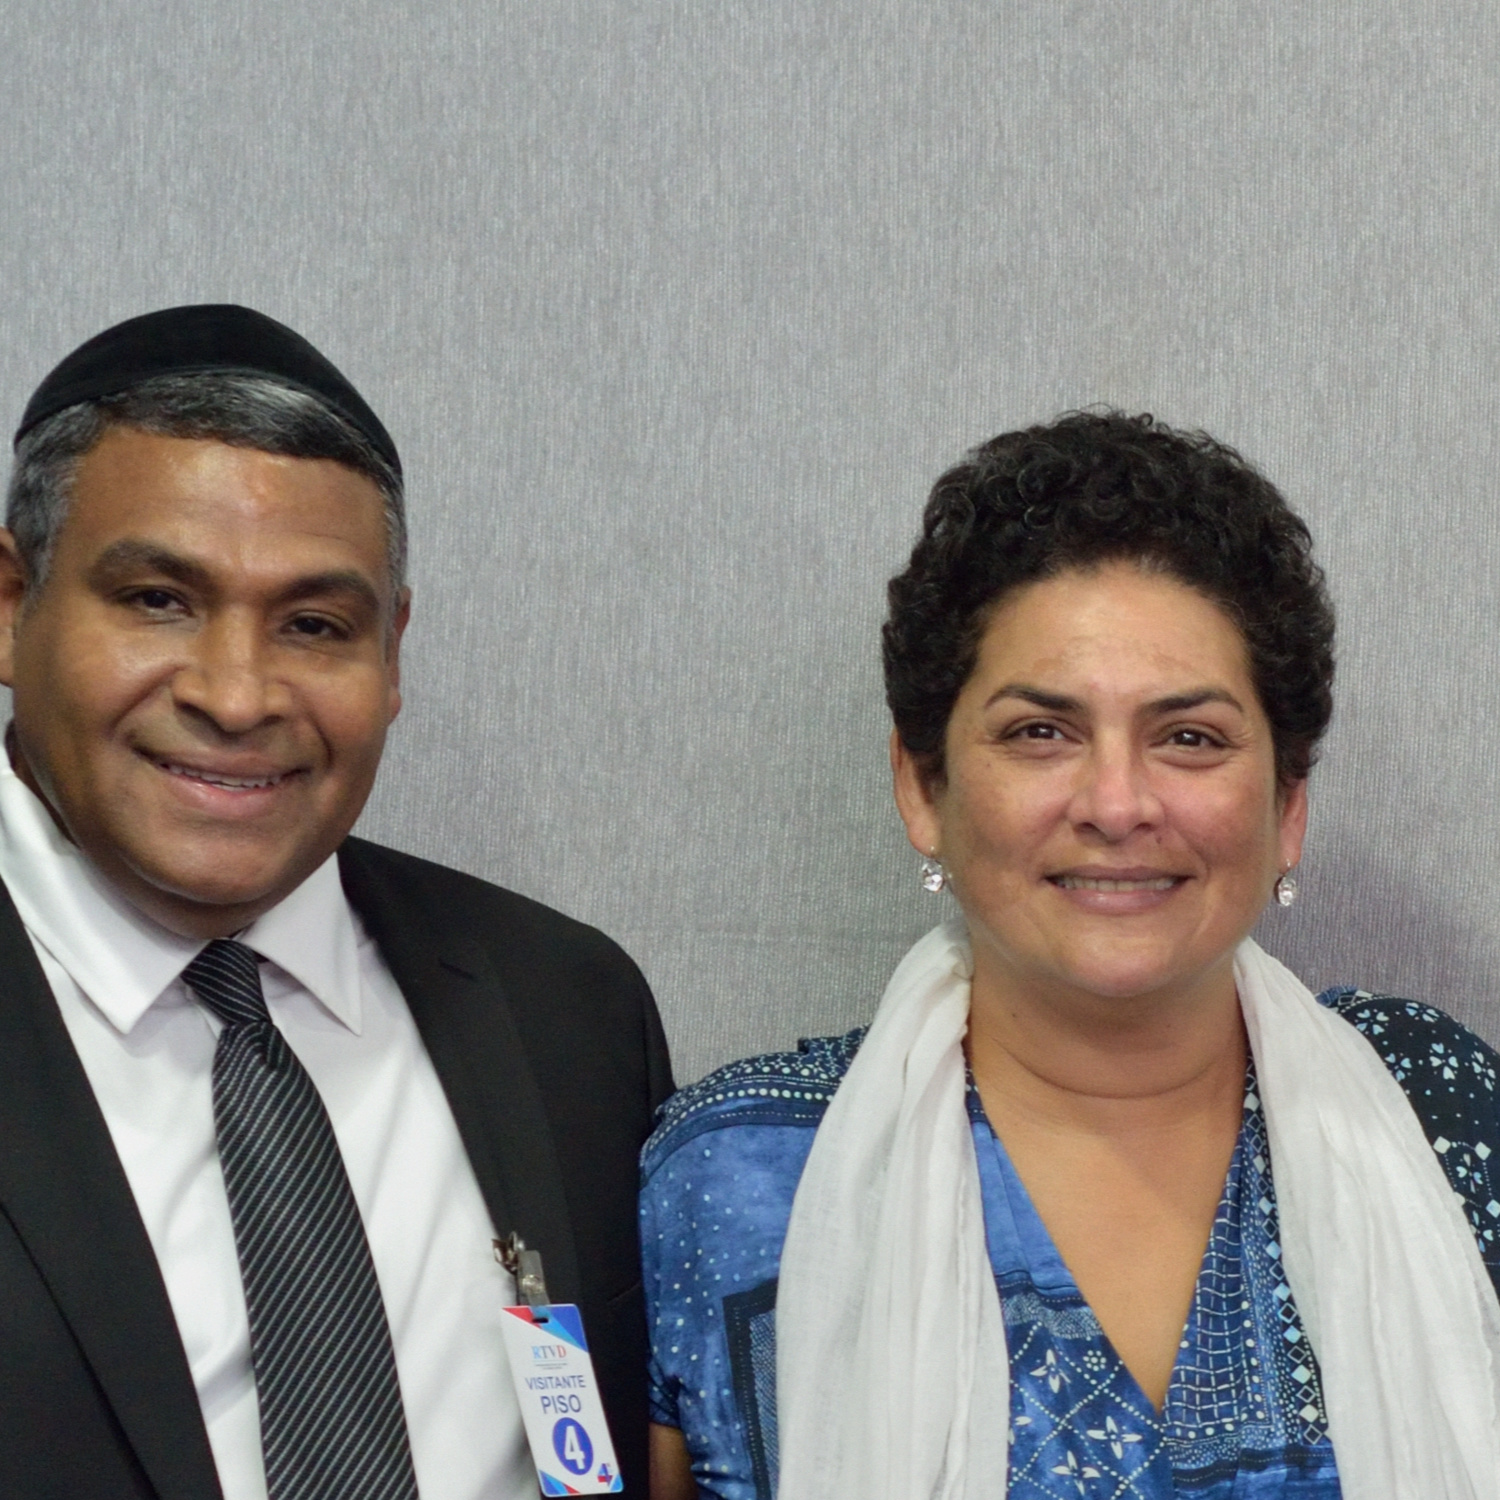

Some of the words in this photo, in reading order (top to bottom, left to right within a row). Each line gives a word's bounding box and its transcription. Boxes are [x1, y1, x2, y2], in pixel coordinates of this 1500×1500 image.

[532, 1345, 567, 1360] RTVD
[525, 1374, 587, 1391] VISITANTE
[540, 1394, 582, 1415] PISO
[564, 1425, 586, 1470] 4
